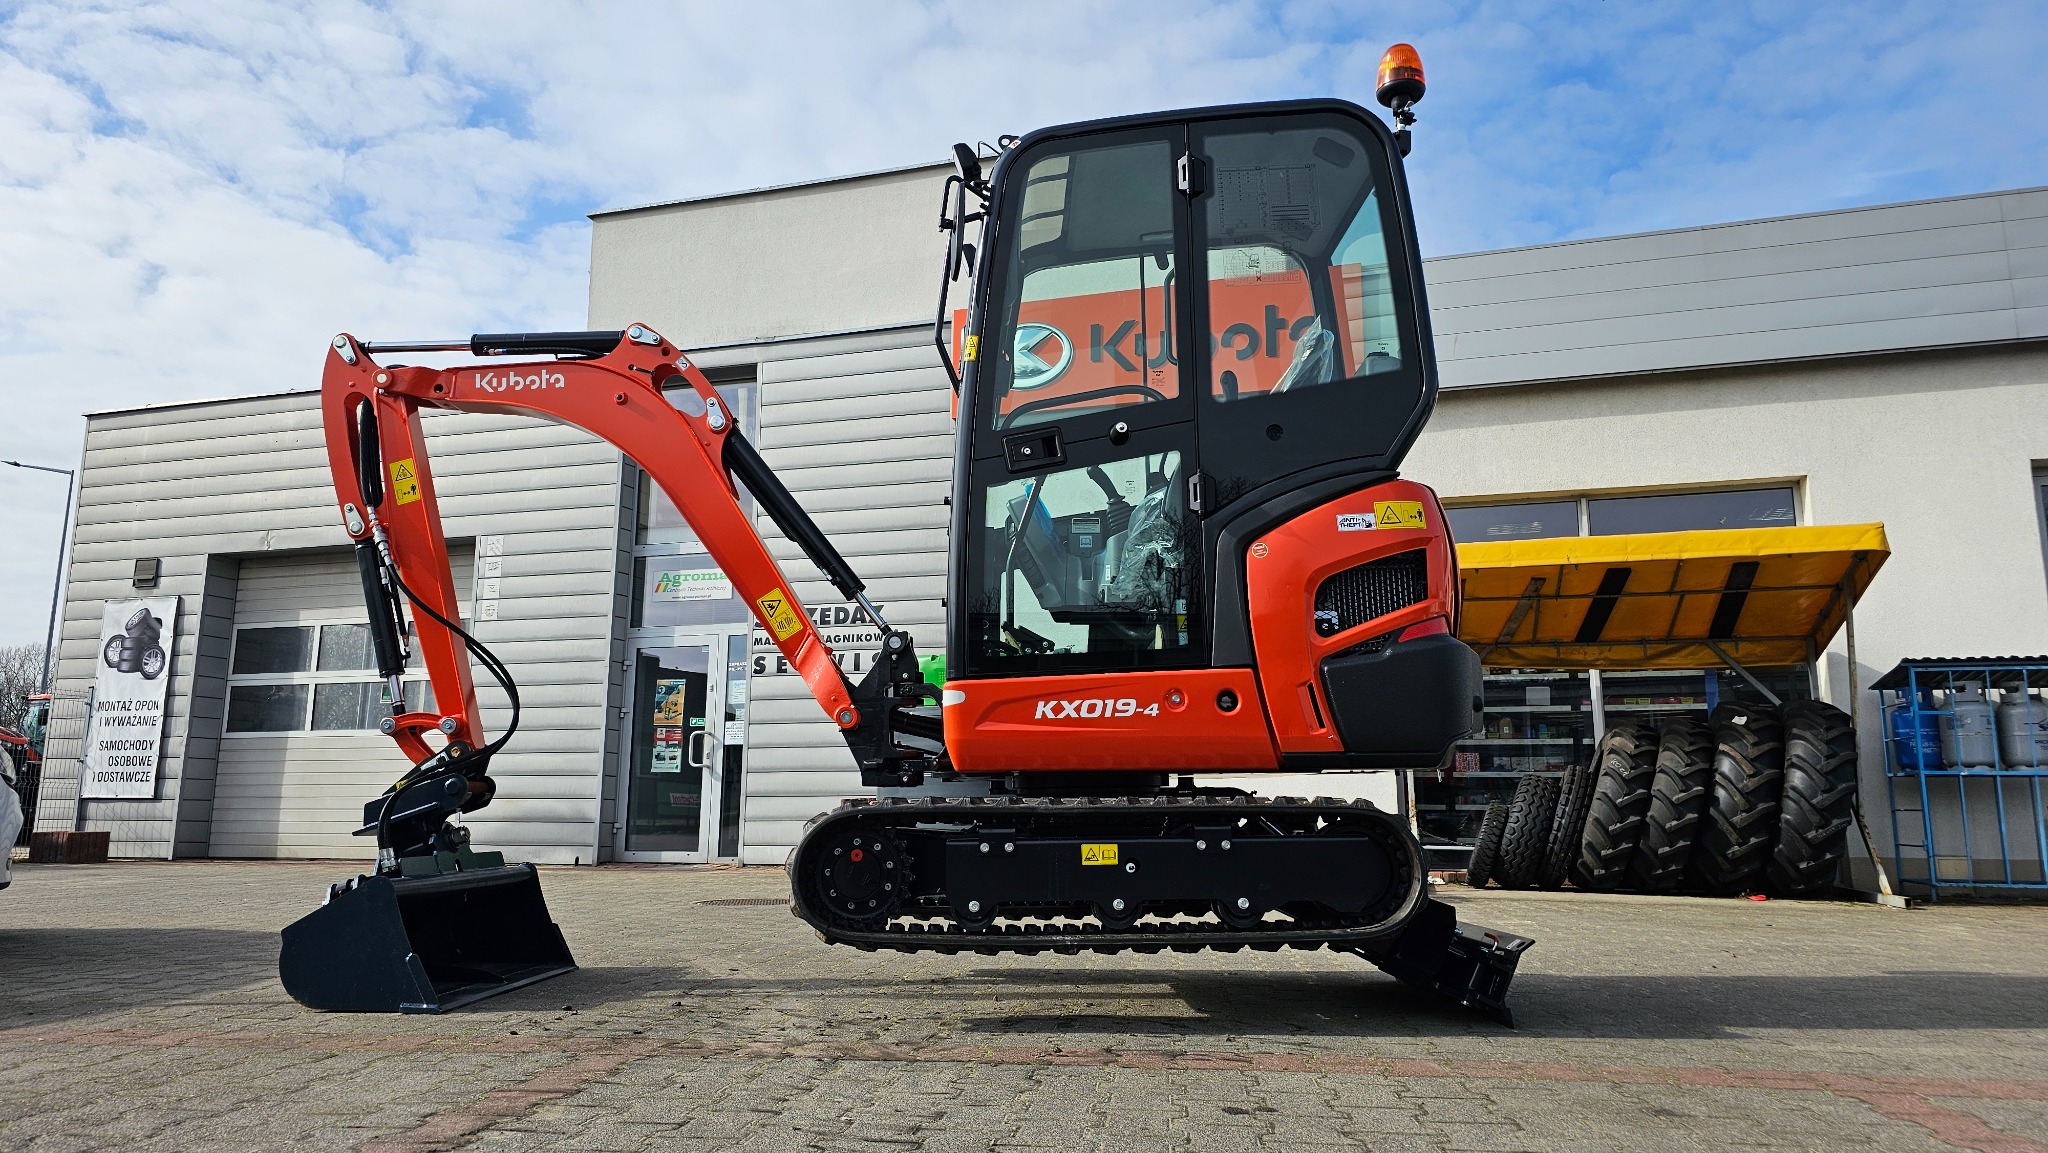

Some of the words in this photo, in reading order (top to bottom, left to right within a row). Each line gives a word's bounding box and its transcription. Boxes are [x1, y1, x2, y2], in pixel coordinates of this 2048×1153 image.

[475, 369, 565, 393] Kubota
[97, 697, 133, 712] MONTAŻ
[134, 700, 160, 711] OPON
[1034, 698, 1159, 719] KX019-4
[104, 713, 158, 727] WYWAŻANIE
[98, 739, 155, 751] SAMOCHODY
[108, 755, 153, 767] OSOBOWE
[97, 771, 151, 783] DOSTAWCZE
